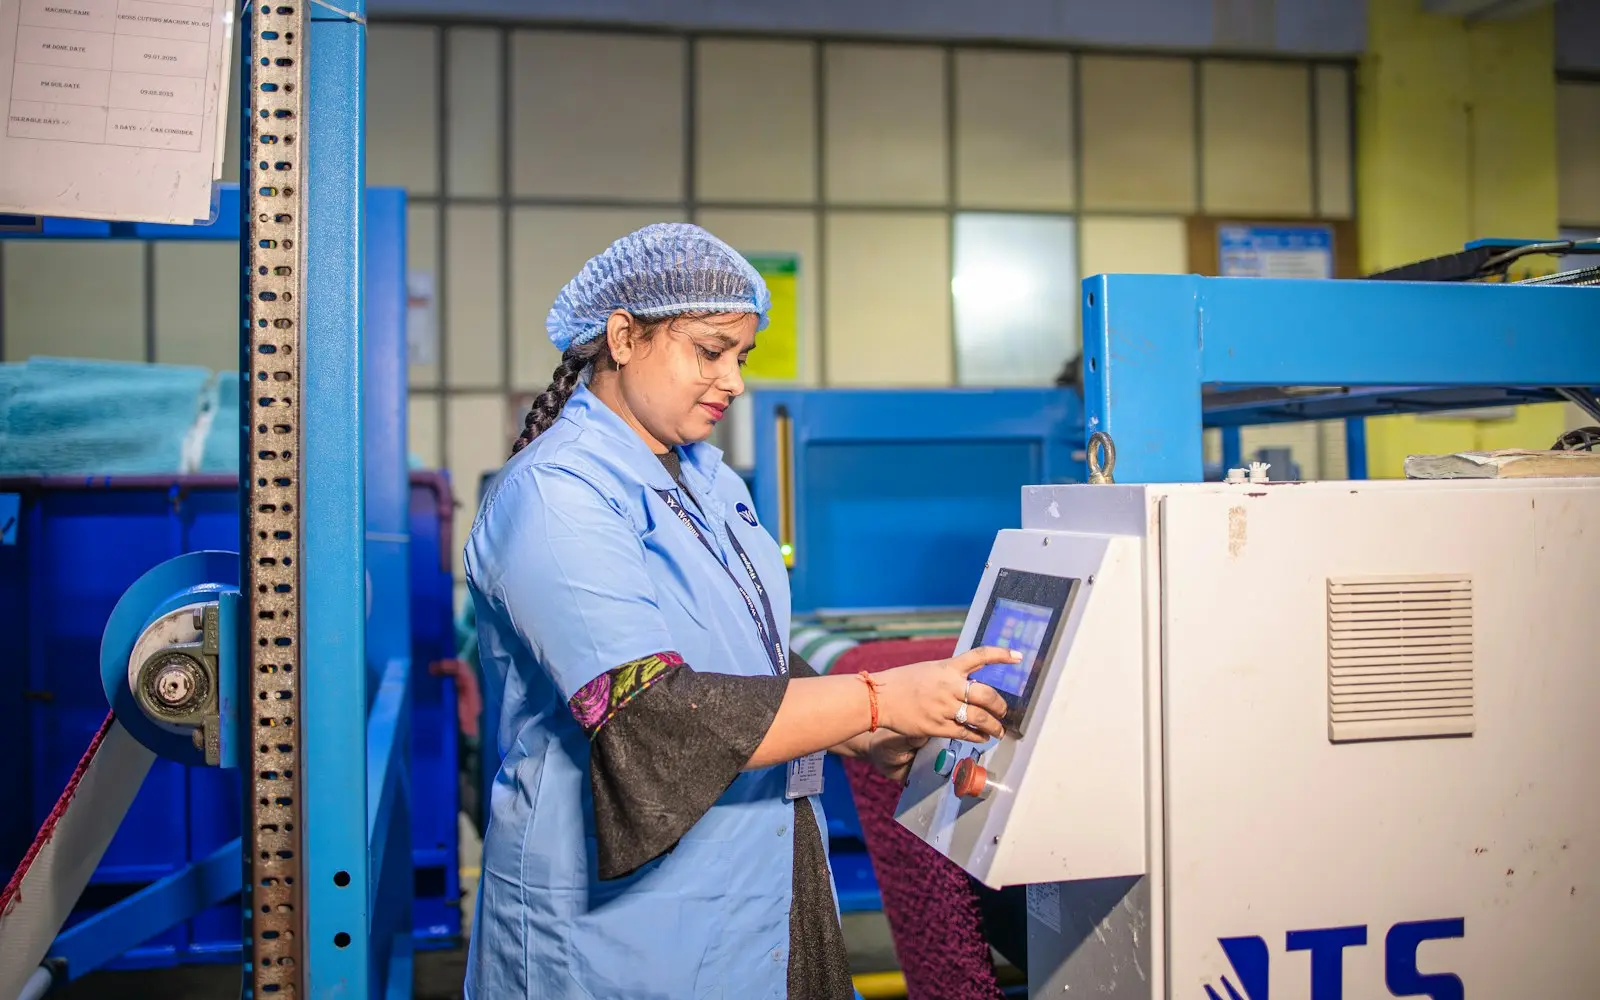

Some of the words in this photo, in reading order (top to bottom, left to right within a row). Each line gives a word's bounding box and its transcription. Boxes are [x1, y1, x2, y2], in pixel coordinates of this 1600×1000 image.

[44, 6, 73, 15] MACHINE
[73, 9, 90, 17] NAME
[163, 18, 190, 26] MACHINE
[10, 116, 42, 124] TOLERABLE
[164, 128, 194, 136] CONSIDER
[740, 553, 756, 580] Welspun
[739, 587, 756, 616] Welspun
[775, 643, 787, 674] Welspun
